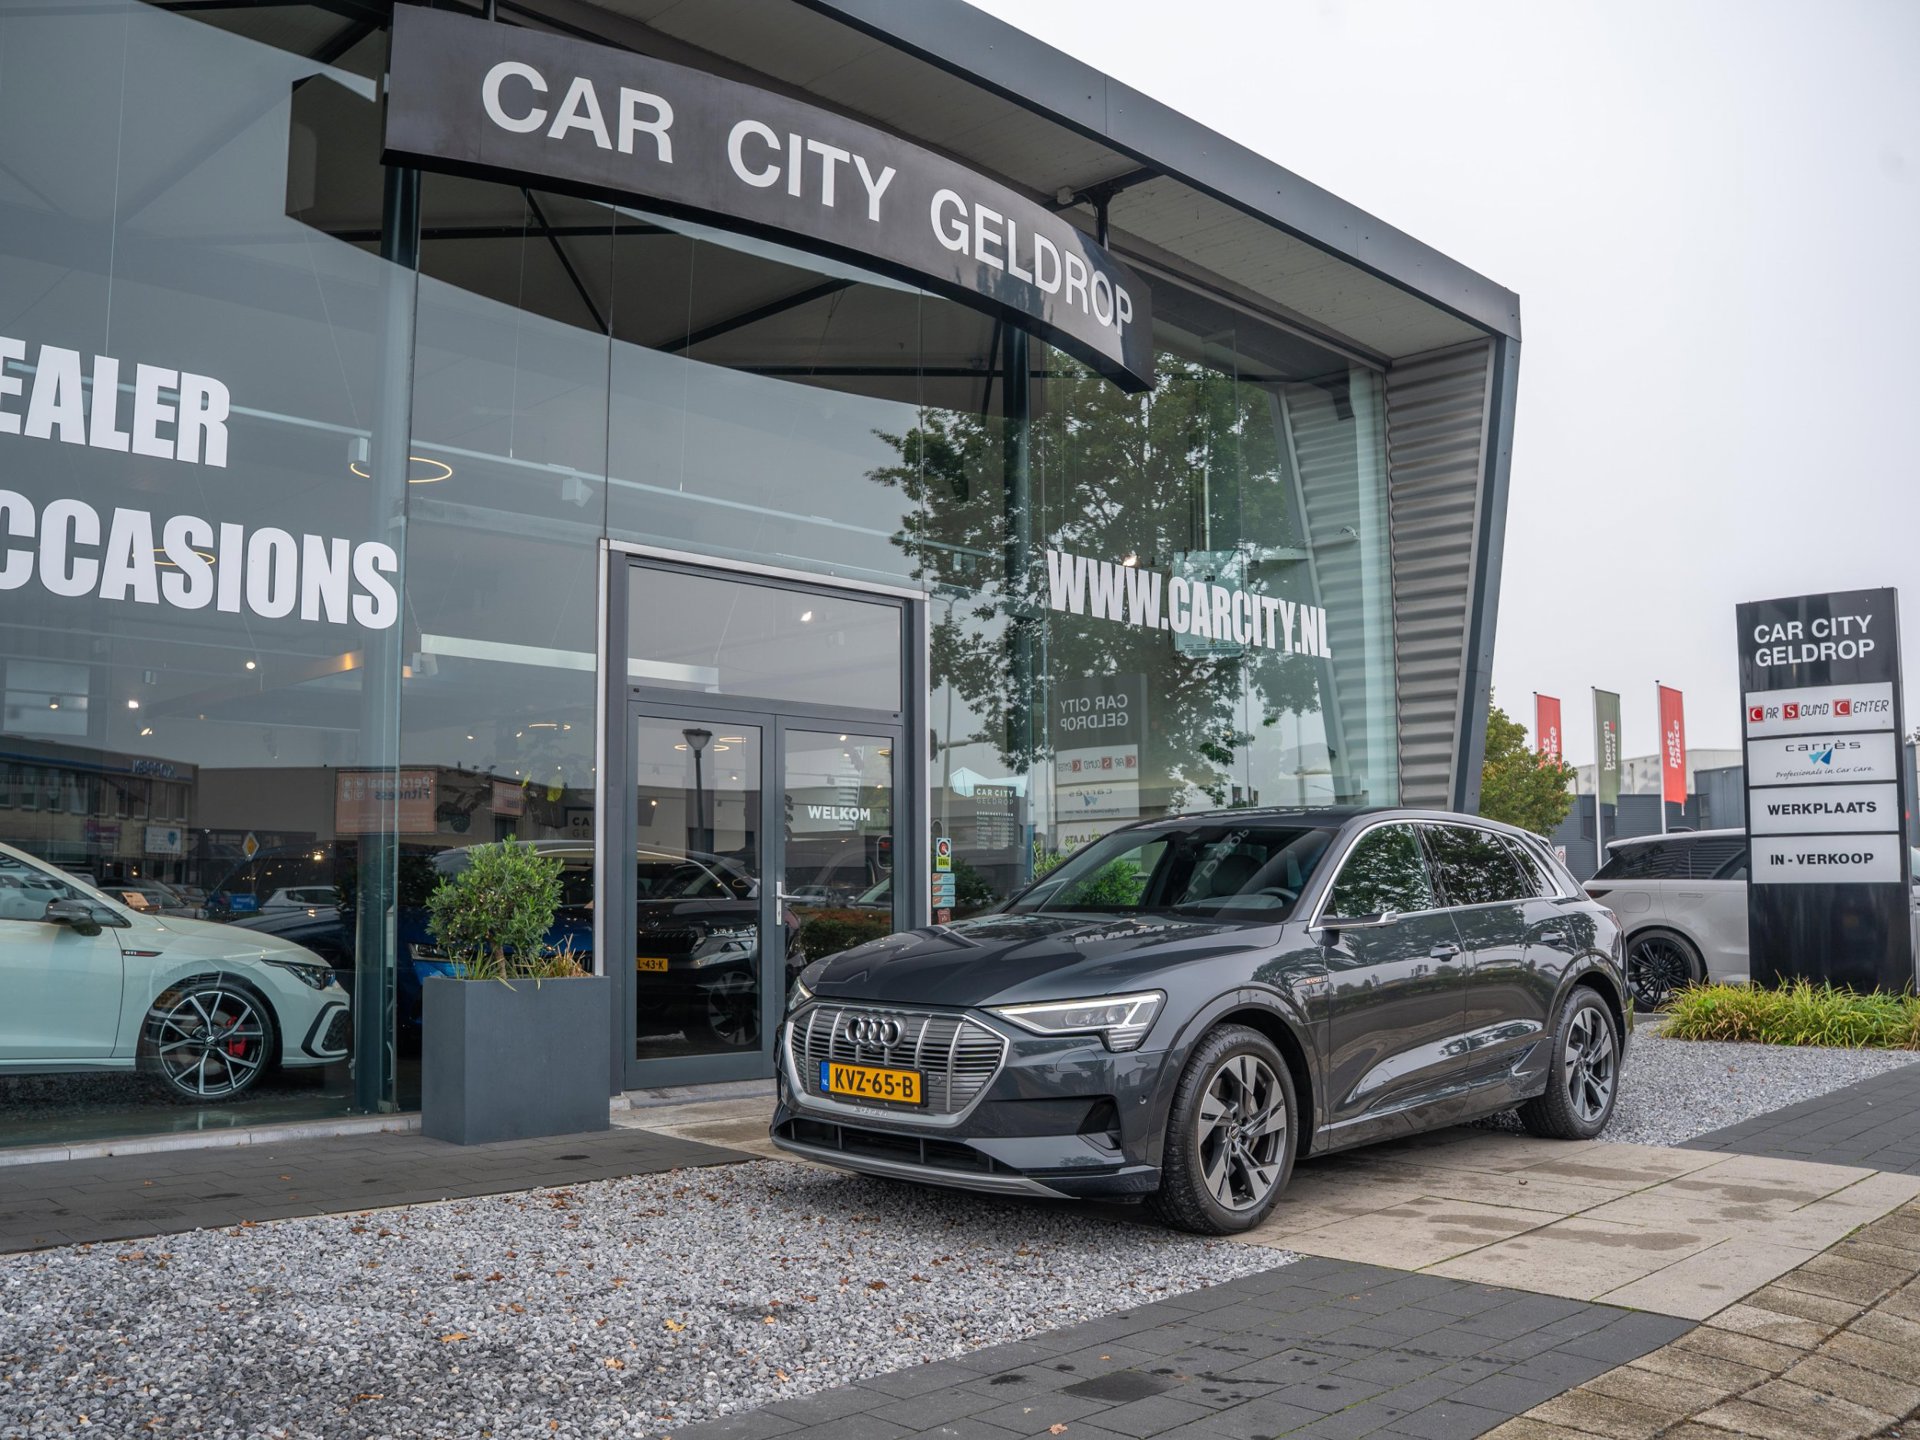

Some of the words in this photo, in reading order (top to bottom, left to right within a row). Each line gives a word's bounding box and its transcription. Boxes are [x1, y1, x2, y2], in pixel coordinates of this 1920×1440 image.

[482, 61, 674, 164] CAR
[728, 119, 896, 222] CITY
[930, 189, 1133, 337] GELDROP
[0, 336, 230, 468] EALER
[0, 489, 398, 629] CCASIONS
[1047, 549, 1331, 659] WWW.CARCITY.NL
[1754, 621, 1804, 644] CAR
[1811, 614, 1872, 638] CITY
[1755, 639, 1875, 667] GELDROP
[1783, 703, 1829, 719] SOUND
[1835, 699, 1889, 716] CENTER
[1667, 731, 1678, 768] pets
[1785, 740, 1861, 752] carrès
[977, 788, 992, 796] CAR
[994, 789, 1014, 798] CITY
[808, 805, 871, 821] WELKOM
[1767, 801, 1877, 815] WERKPLAATS
[1770, 854, 1784, 865] IN
[1796, 853, 1874, 865] VERKOOP
[821, 1078, 829, 1086] NL
[835, 1067, 913, 1098] KVZ-65-B
